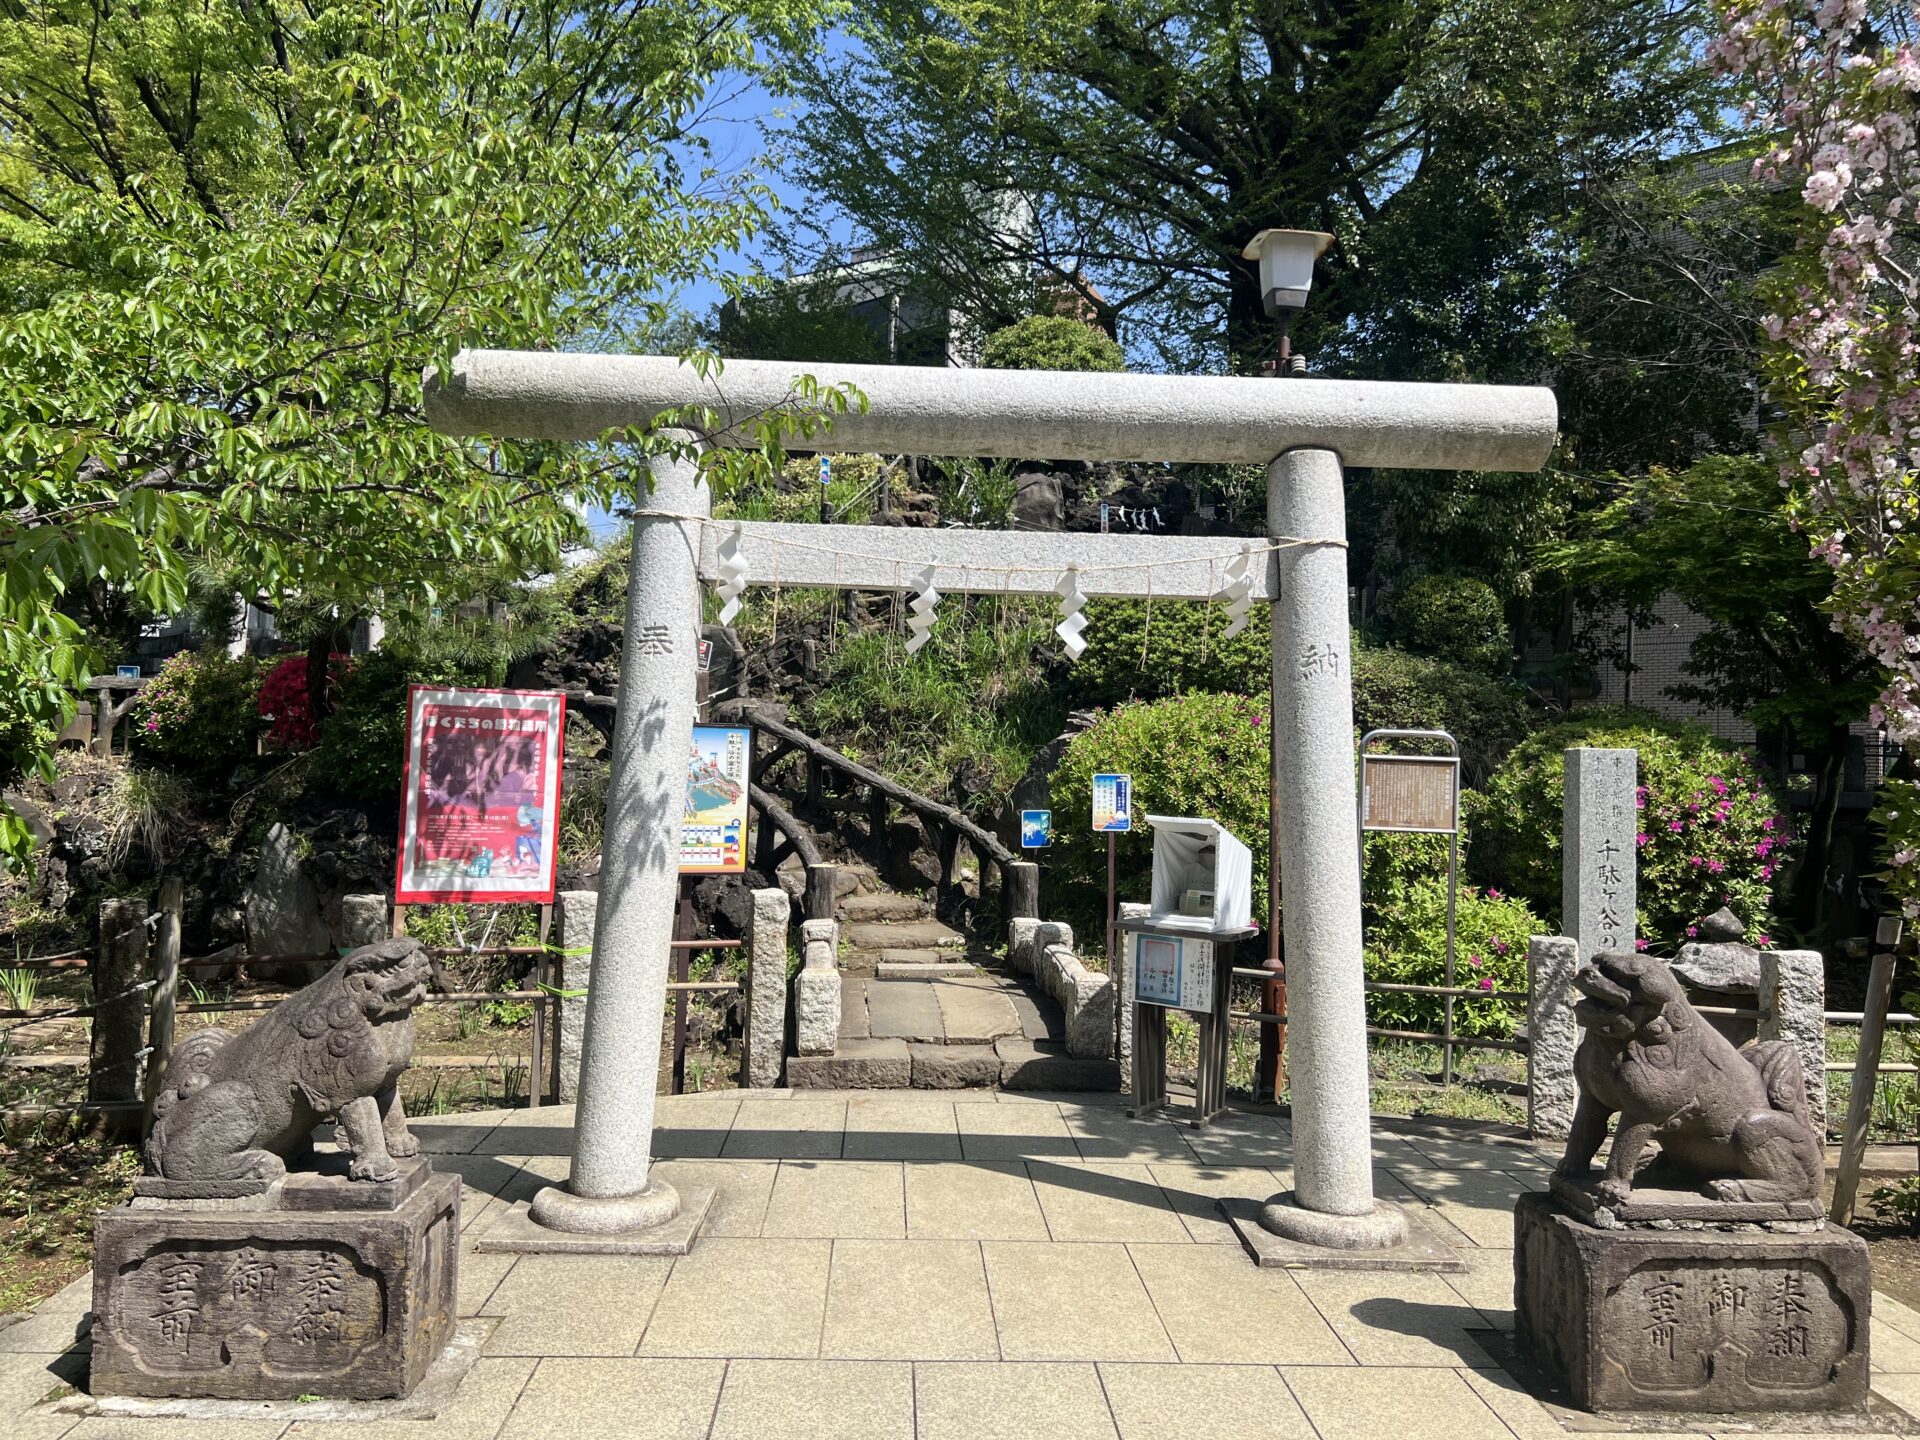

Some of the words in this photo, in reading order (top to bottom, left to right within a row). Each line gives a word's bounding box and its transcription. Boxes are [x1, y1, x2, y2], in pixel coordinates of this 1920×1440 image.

[637, 621, 674, 657] 奉
[1299, 643, 1339, 681] 納
[1610, 756, 1623, 834] 東京都指定
[220, 1247, 279, 1302] 御
[292, 1250, 346, 1345] 奉納
[1707, 1273, 1749, 1323] 御
[1765, 1273, 1813, 1358] 奉納
